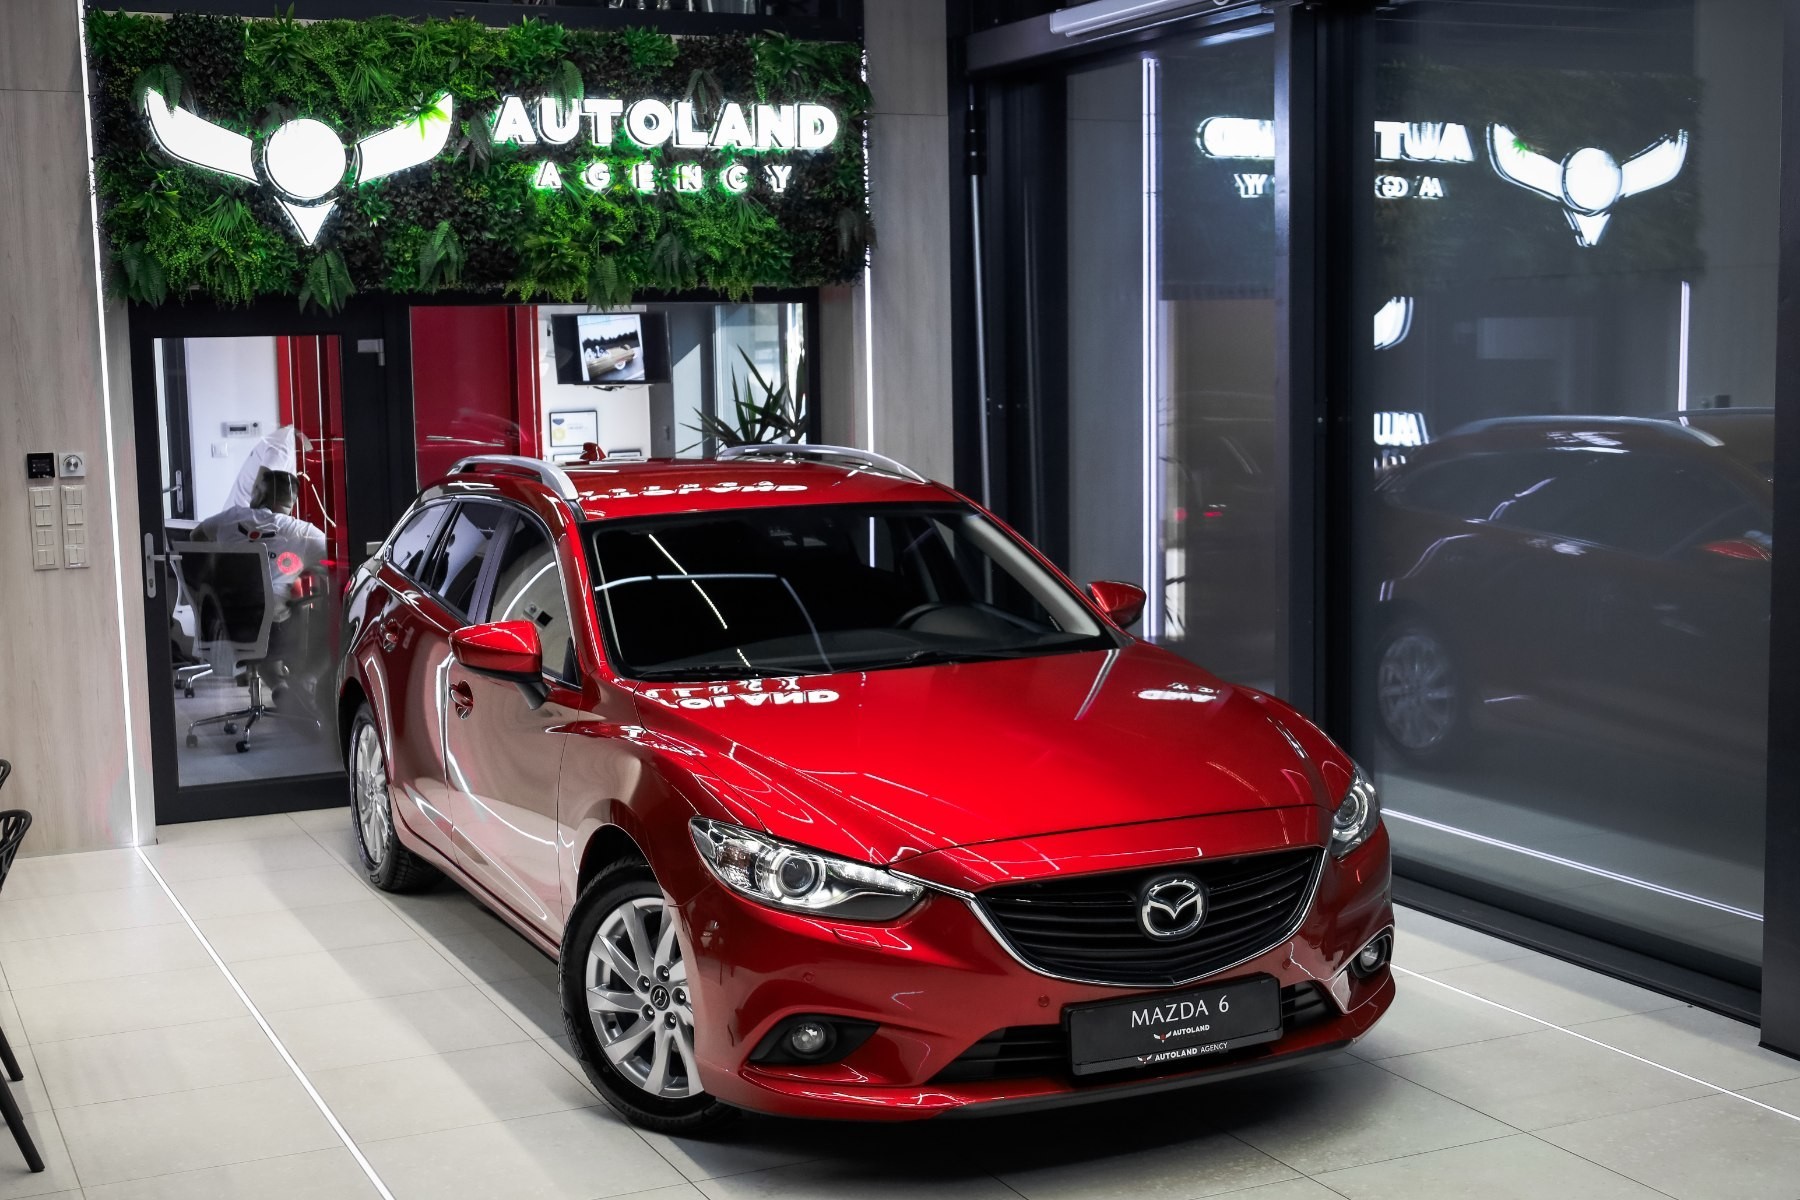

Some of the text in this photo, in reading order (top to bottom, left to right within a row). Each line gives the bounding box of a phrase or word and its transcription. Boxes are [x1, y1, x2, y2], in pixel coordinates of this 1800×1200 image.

[494, 95, 839, 149] AUTOLAND
[535, 160, 793, 194] AGENCY
[1131, 995, 1229, 1027] MAZDA 6
[1172, 1024, 1210, 1036] AUTOLAND
[1155, 1042, 1228, 1062] AUTOLAND AGENCY
